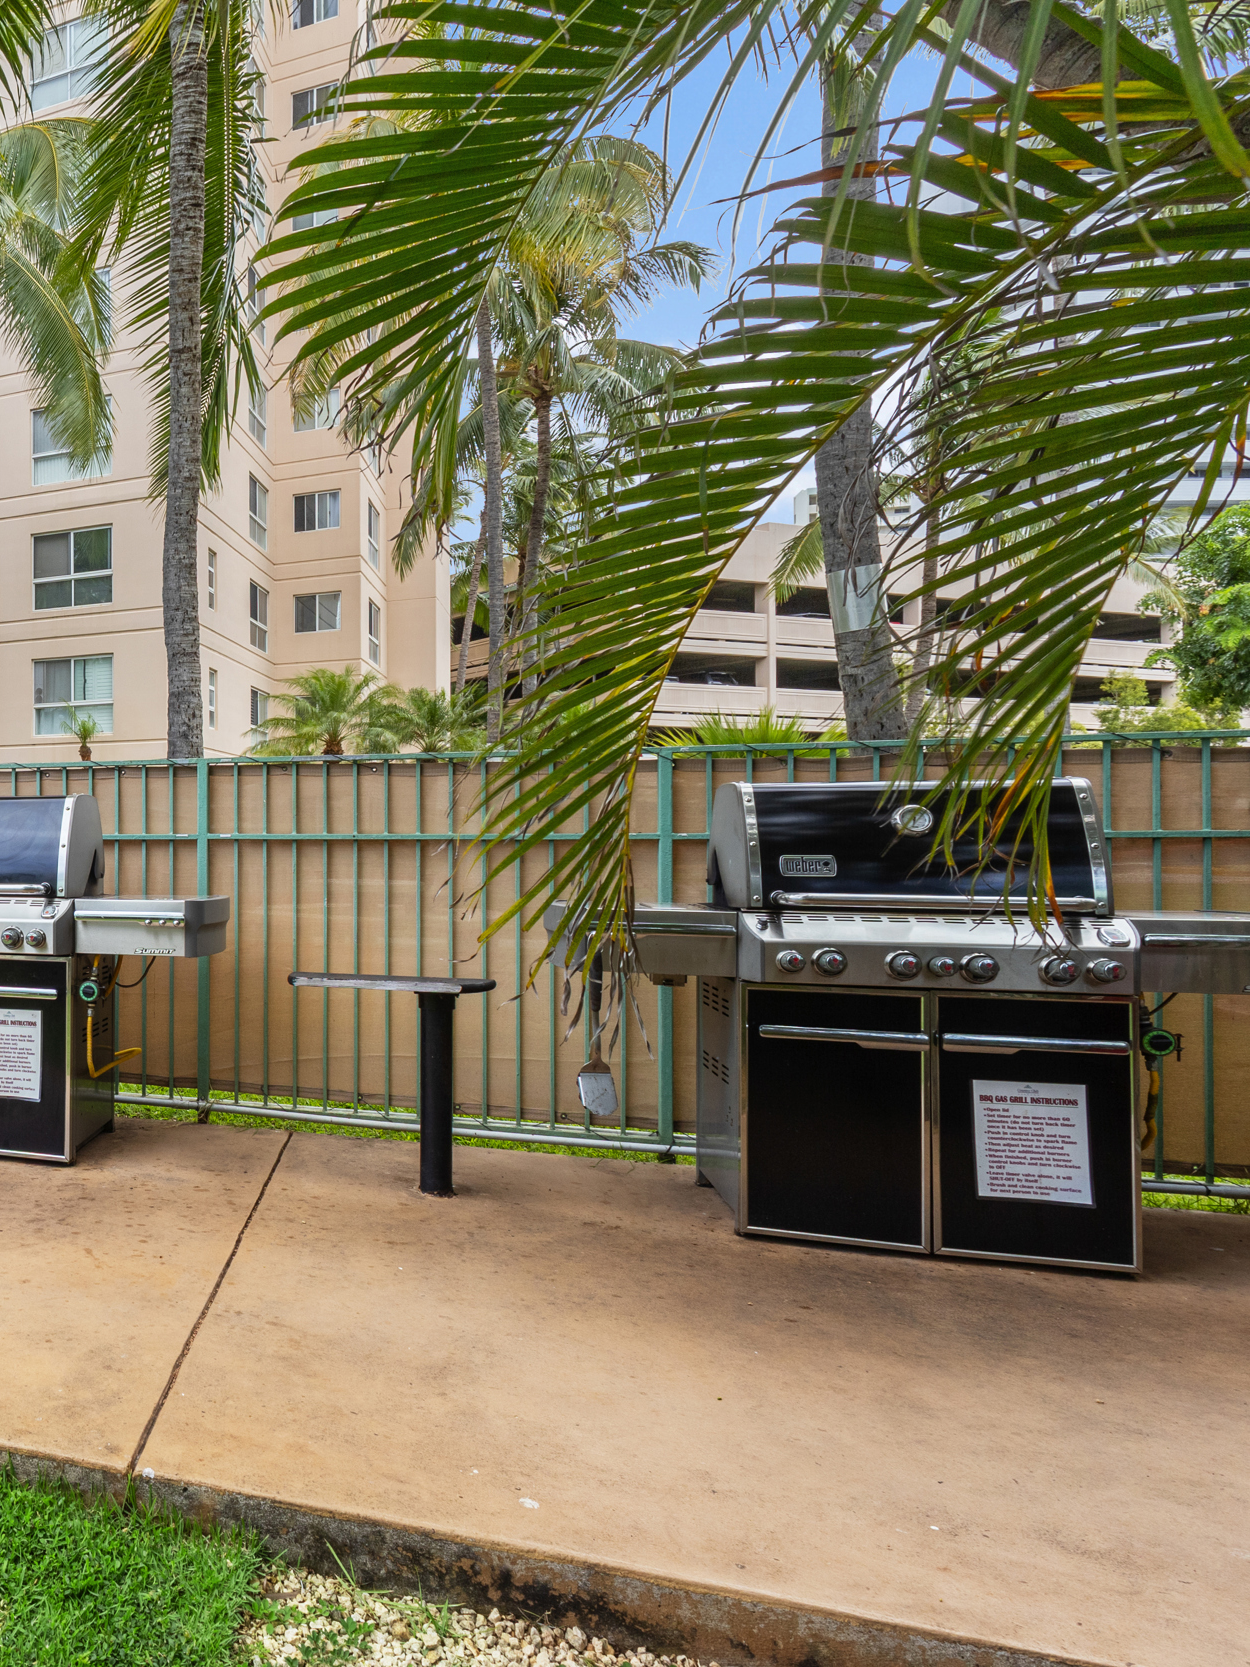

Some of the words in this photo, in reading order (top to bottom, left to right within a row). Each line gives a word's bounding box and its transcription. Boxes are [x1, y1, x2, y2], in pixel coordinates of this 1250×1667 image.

[786, 856, 820, 872] weber
[995, 1095, 1008, 1103] GAS
[1010, 1096, 1029, 1104] GRILL
[1030, 1097, 1078, 1106] INSTRUCTIONS
